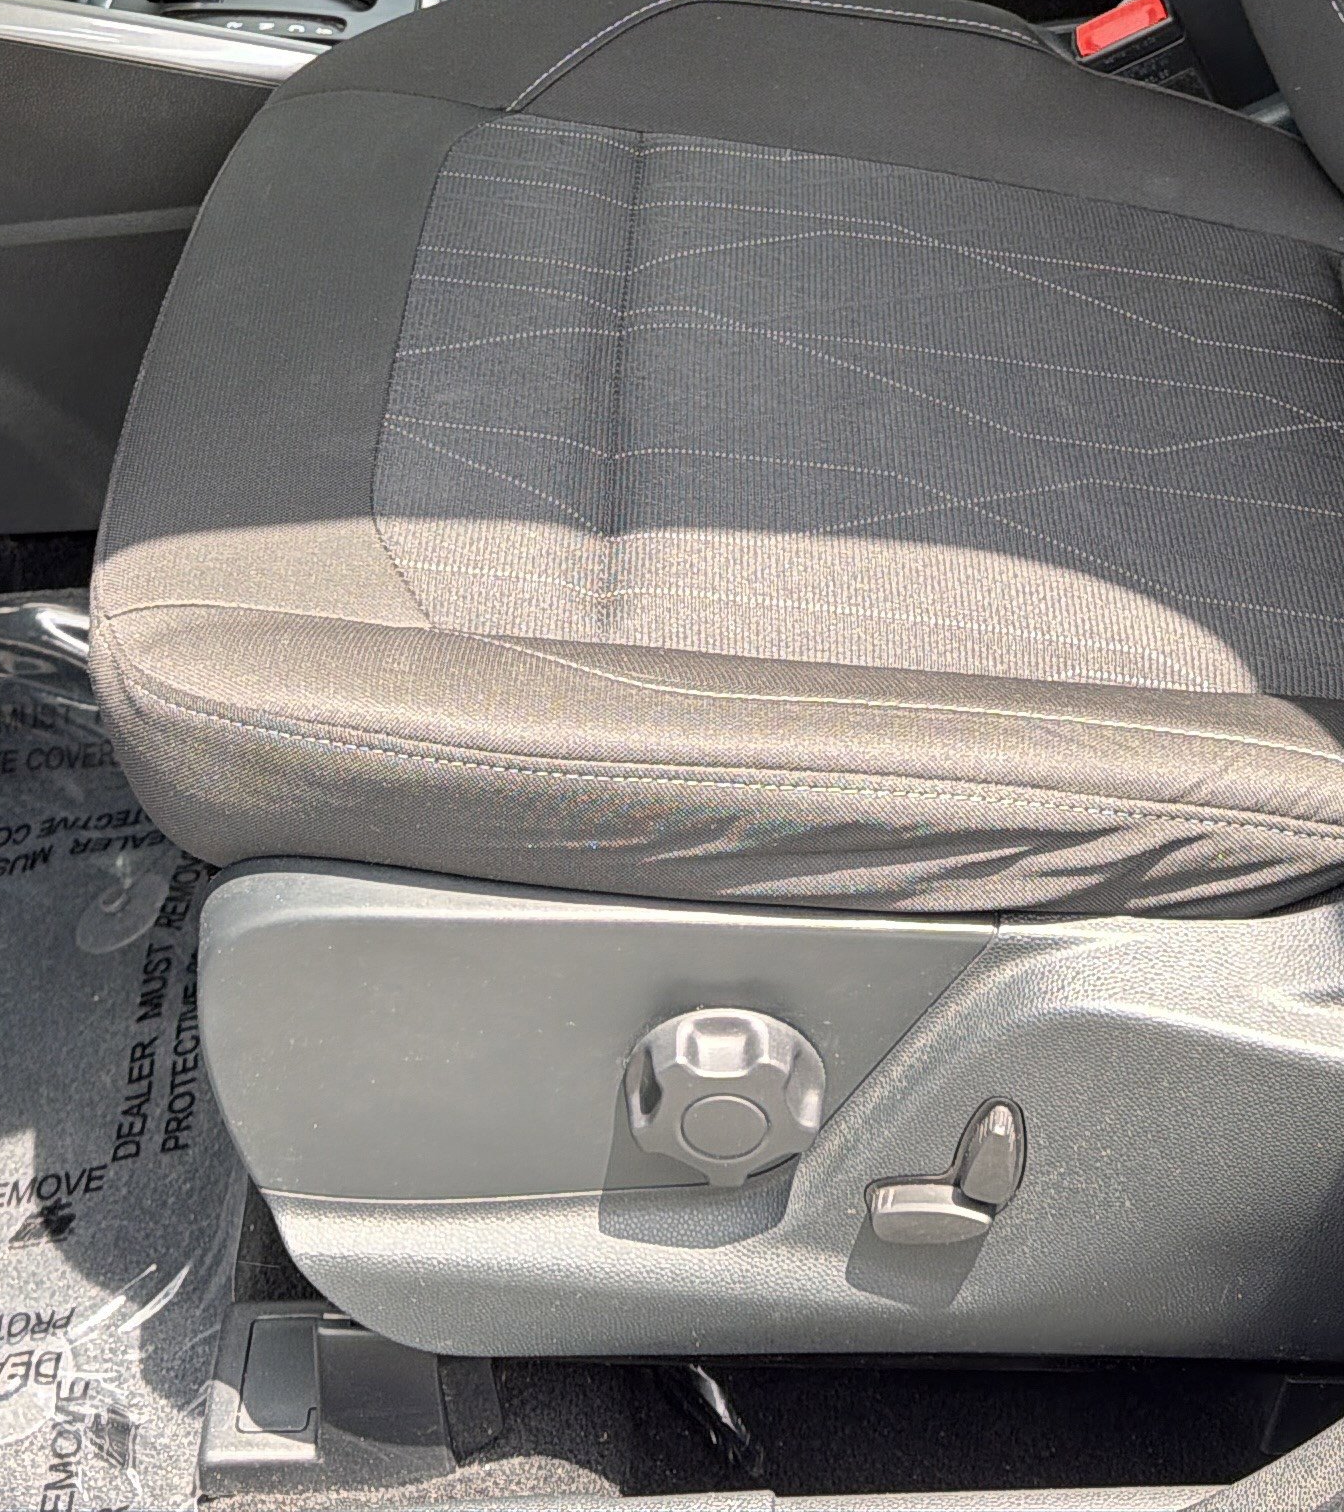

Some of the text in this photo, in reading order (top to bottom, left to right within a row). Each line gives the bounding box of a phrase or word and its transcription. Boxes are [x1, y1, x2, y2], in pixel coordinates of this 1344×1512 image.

[25, 739, 120, 774] COVER
[69, 829, 167, 856] EALER
[111, 1036, 159, 1164] DEALER
[136, 943, 174, 1024] MUST
[40, 1379, 91, 1512] EMOVE
